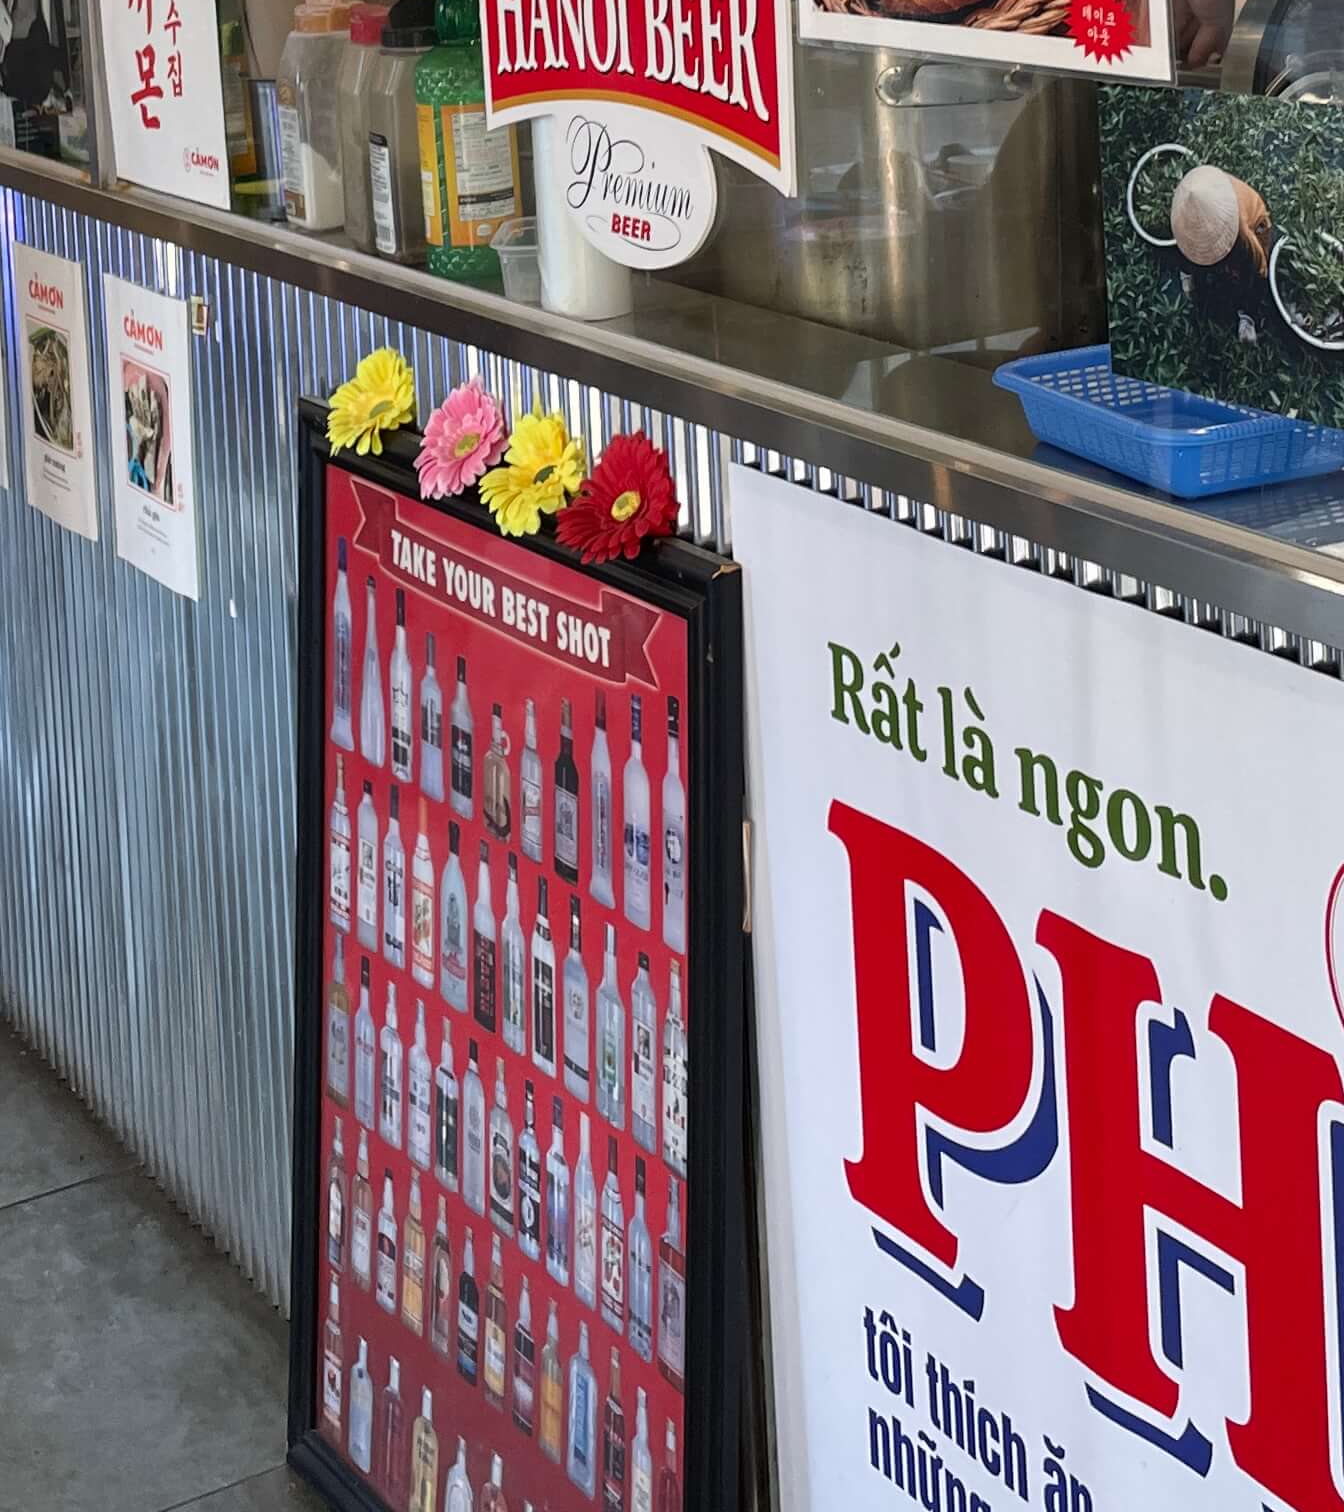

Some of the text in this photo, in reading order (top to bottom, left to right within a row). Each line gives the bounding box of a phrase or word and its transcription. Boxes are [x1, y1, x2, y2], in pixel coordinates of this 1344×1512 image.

[1081, 3, 1117, 27] 테이크
[1087, 25, 1111, 47] 아웃
[190, 147, 220, 173] CẢMƠN
[565, 114, 695, 223] Premium
[610, 212, 653, 244] BEER
[28, 271, 64, 310] CẢMƠN
[123, 307, 164, 353] CẢMƠN
[389, 528, 611, 669] TAKE YOUR BEST SHOT
[826, 640, 1231, 903] Rất là ngon.
[863, 1305, 915, 1409] tôi
